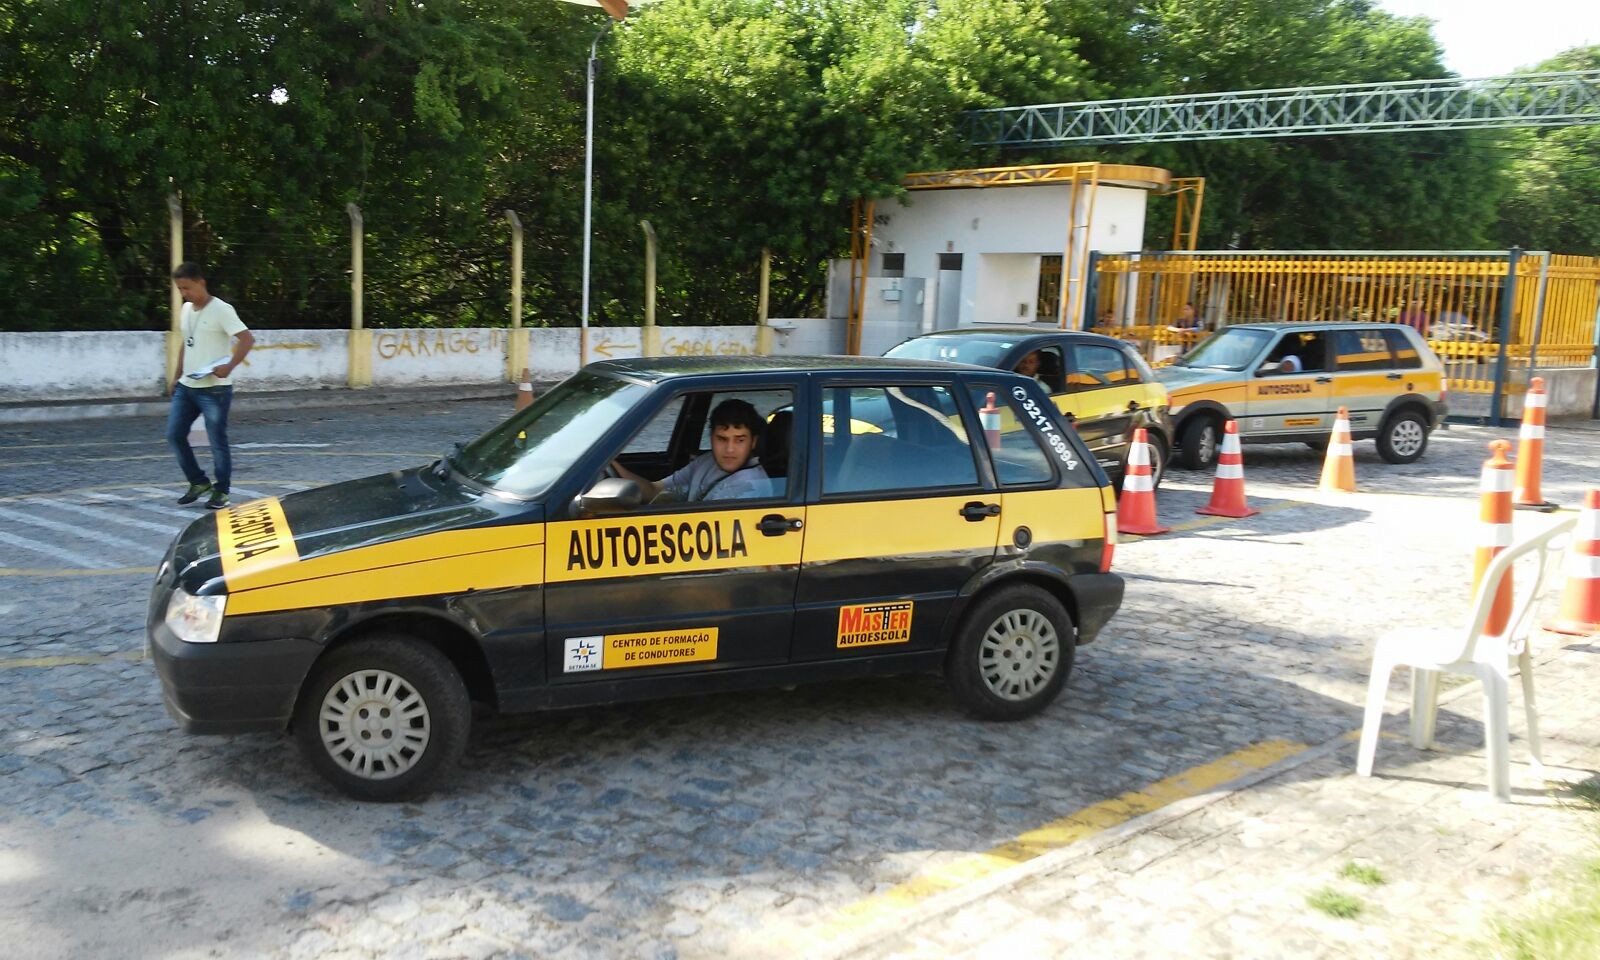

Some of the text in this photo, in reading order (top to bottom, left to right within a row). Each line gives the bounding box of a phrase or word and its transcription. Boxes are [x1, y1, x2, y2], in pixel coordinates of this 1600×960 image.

[377, 329, 480, 359] GARAGE
[1022, 399, 1078, 470] 3217-6994
[567, 519, 748, 571] AUTOESCOLA
[612, 632, 710, 648] CENTRO DE FORMAÇÃO
[840, 630, 908, 644] AUTOESCOLA
[625, 648, 696, 661] DE CONDUTORES
